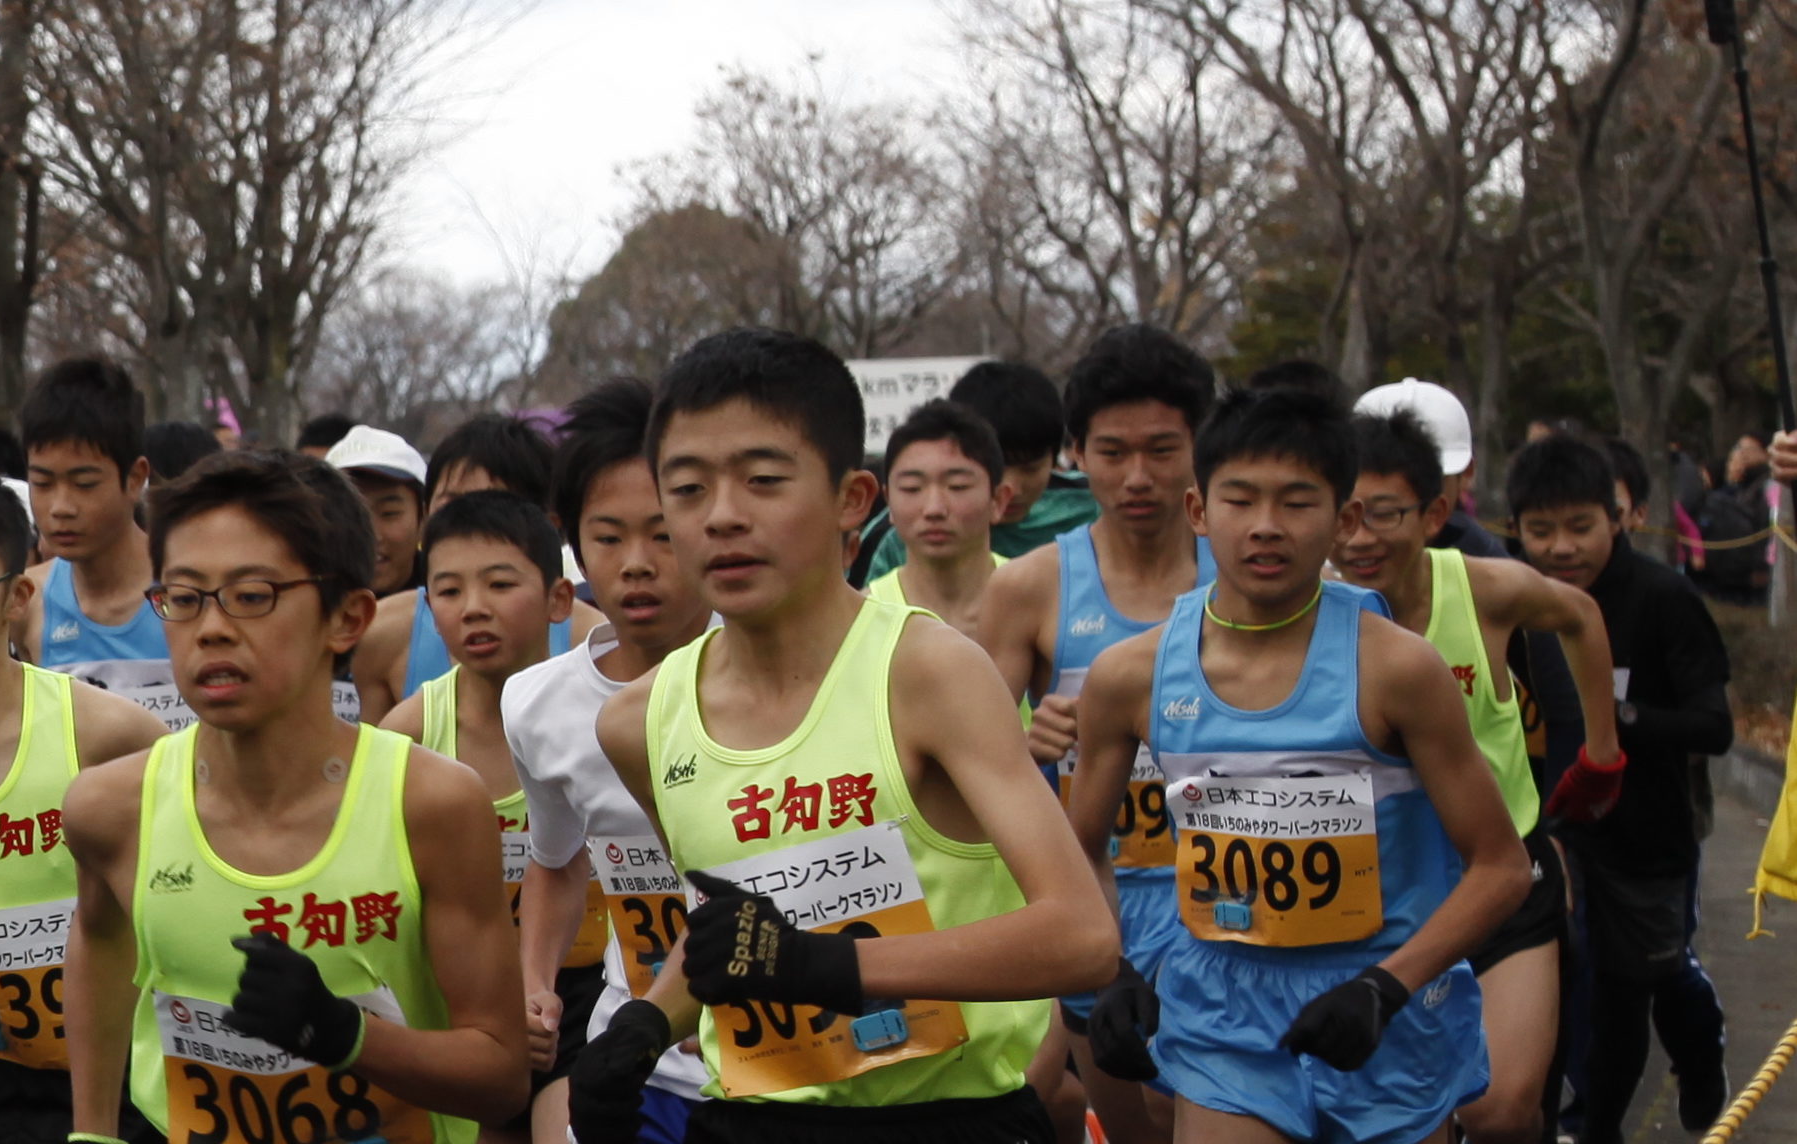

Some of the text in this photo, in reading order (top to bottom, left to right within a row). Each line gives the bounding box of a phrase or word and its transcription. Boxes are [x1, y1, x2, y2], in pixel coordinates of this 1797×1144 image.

[727, 772, 877, 842] 古知野
[1207, 787, 1356, 809] 日本エコシステム
[627, 847, 664, 867] 日本
[1190, 834, 1342, 912] 3089
[243, 891, 403, 949] 古知野
[727, 899, 758, 977] Spazio
